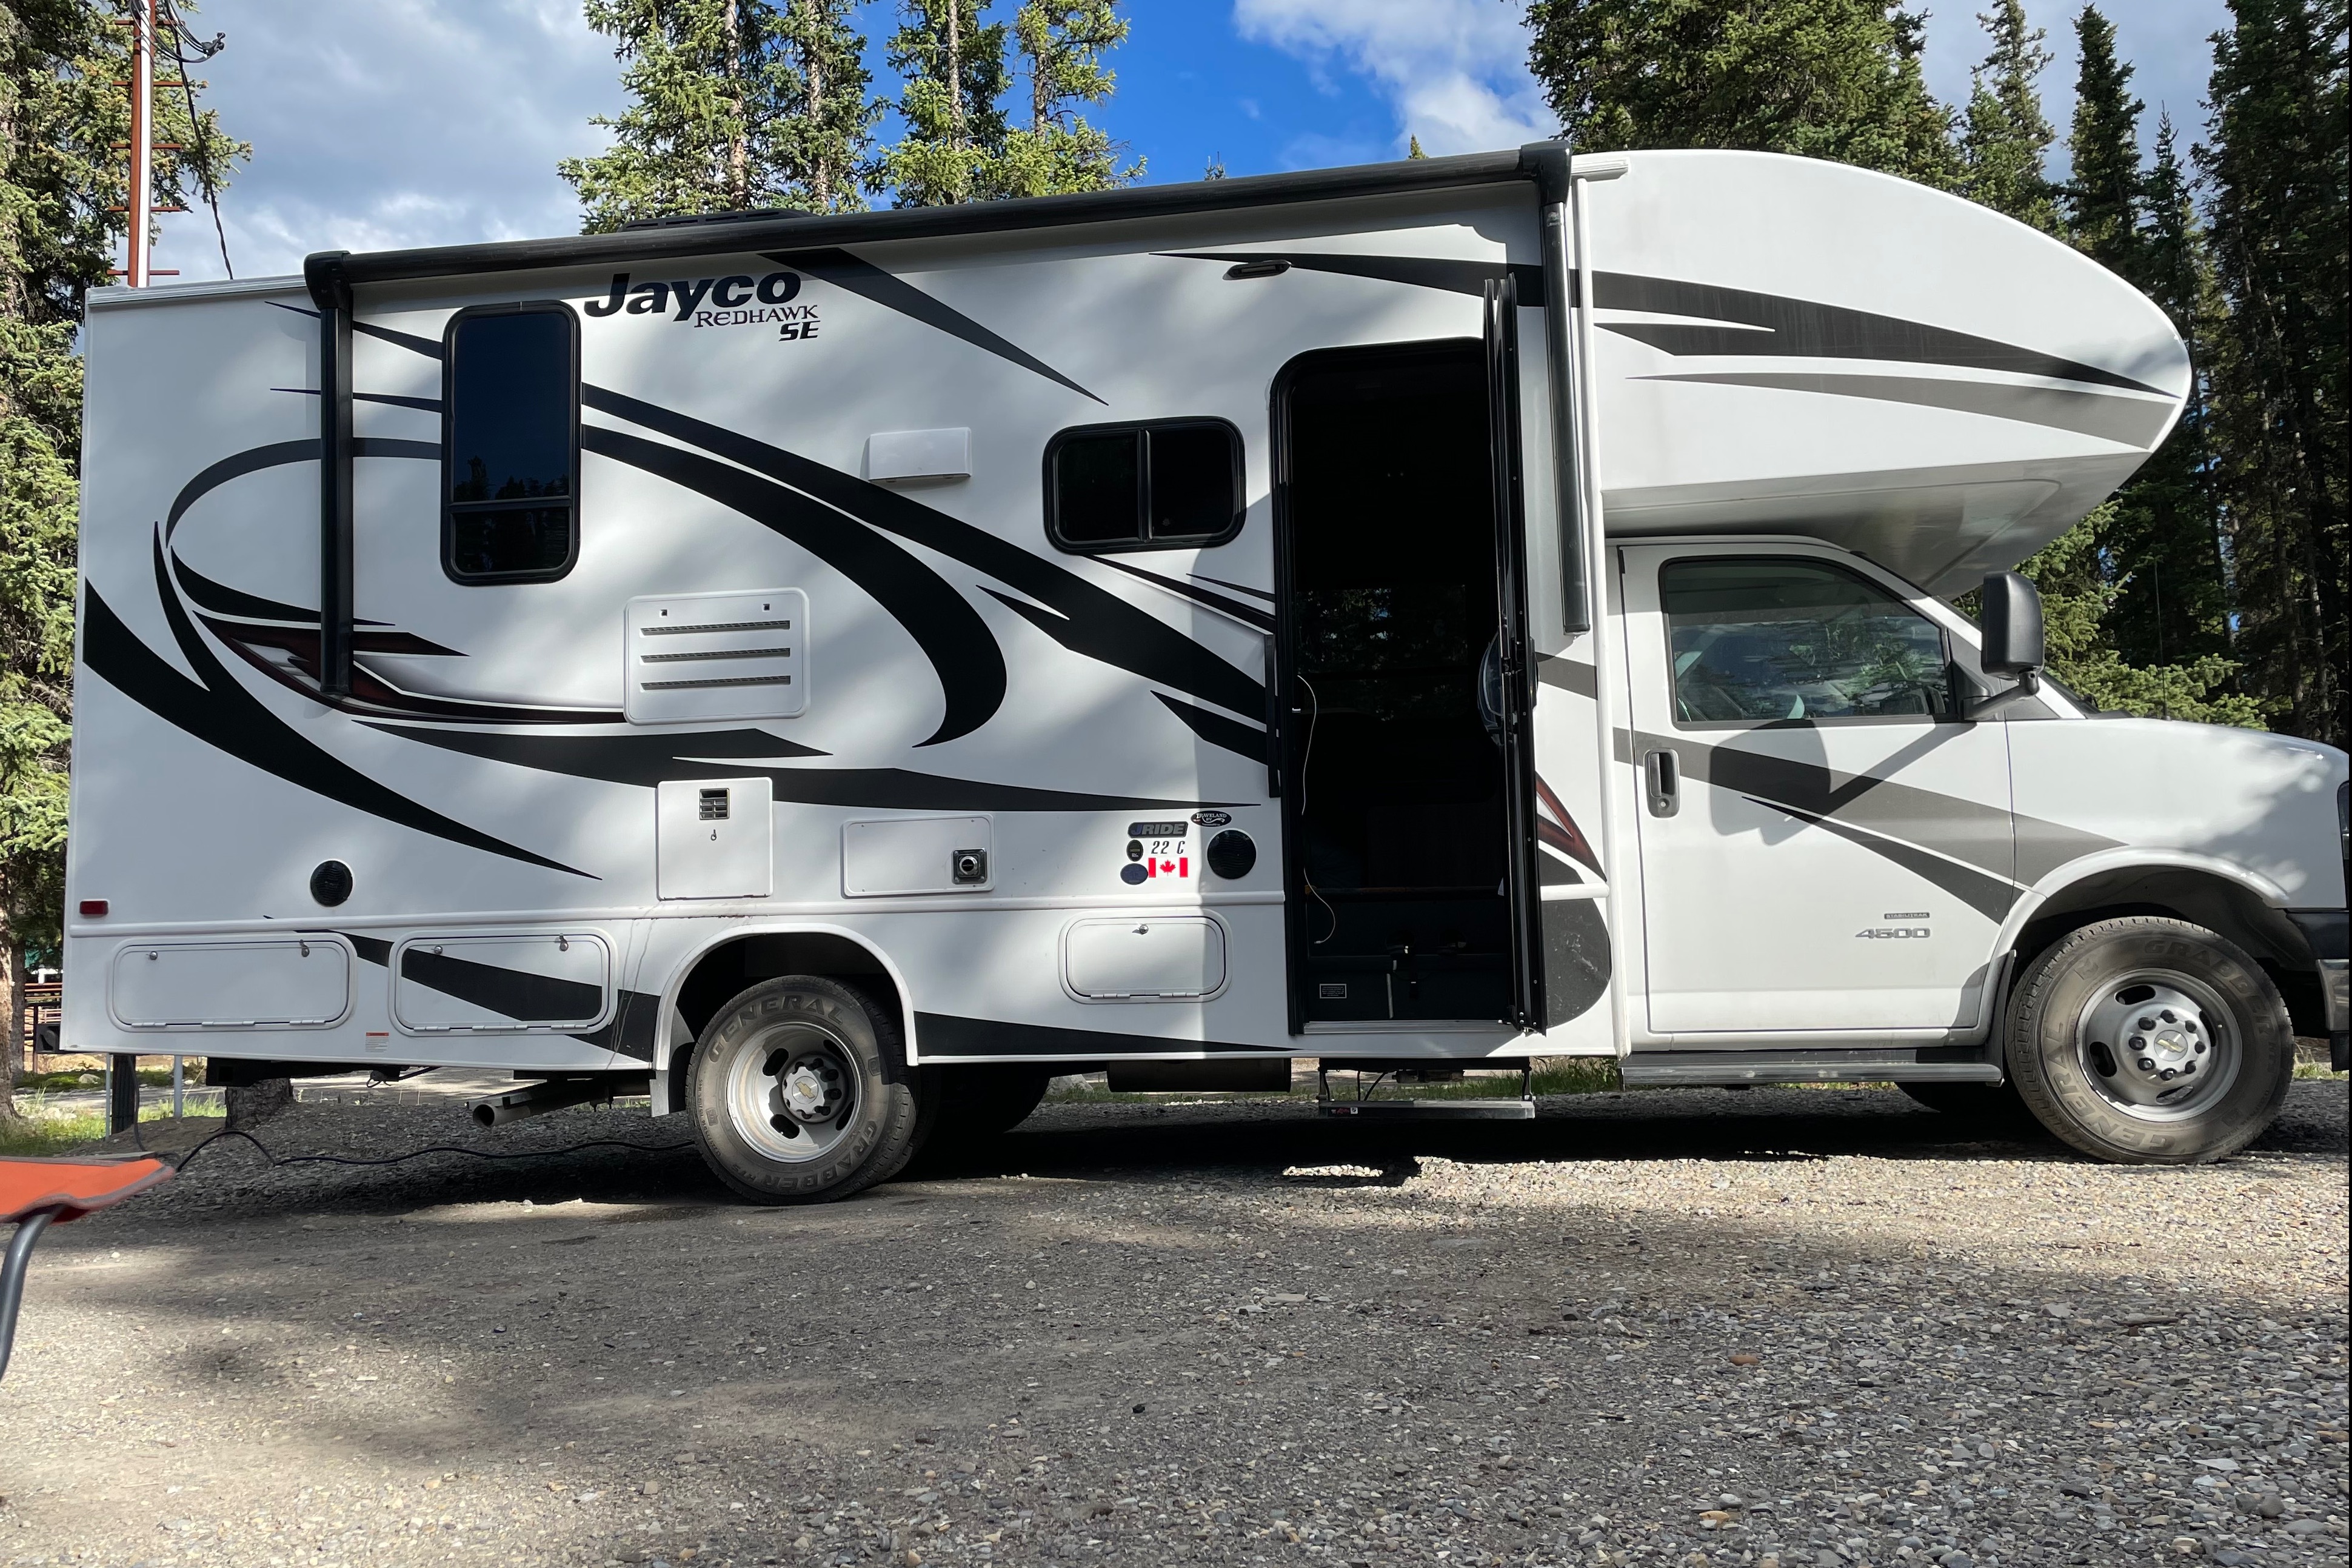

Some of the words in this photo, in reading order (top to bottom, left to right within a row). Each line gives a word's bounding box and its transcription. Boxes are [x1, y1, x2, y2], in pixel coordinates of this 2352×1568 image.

[583, 271, 802, 322] Jayco
[693, 305, 820, 328] REDHAWK
[778, 321, 821, 342] SE
[1151, 840, 1170, 855] 22
[1176, 840, 1186, 854] C
[1855, 928, 1931, 939] 4500
[707, 995, 844, 1063] GENERAL
[2045, 1021, 2176, 1151] GENERAL
[761, 1121, 878, 1189] GRABBER
